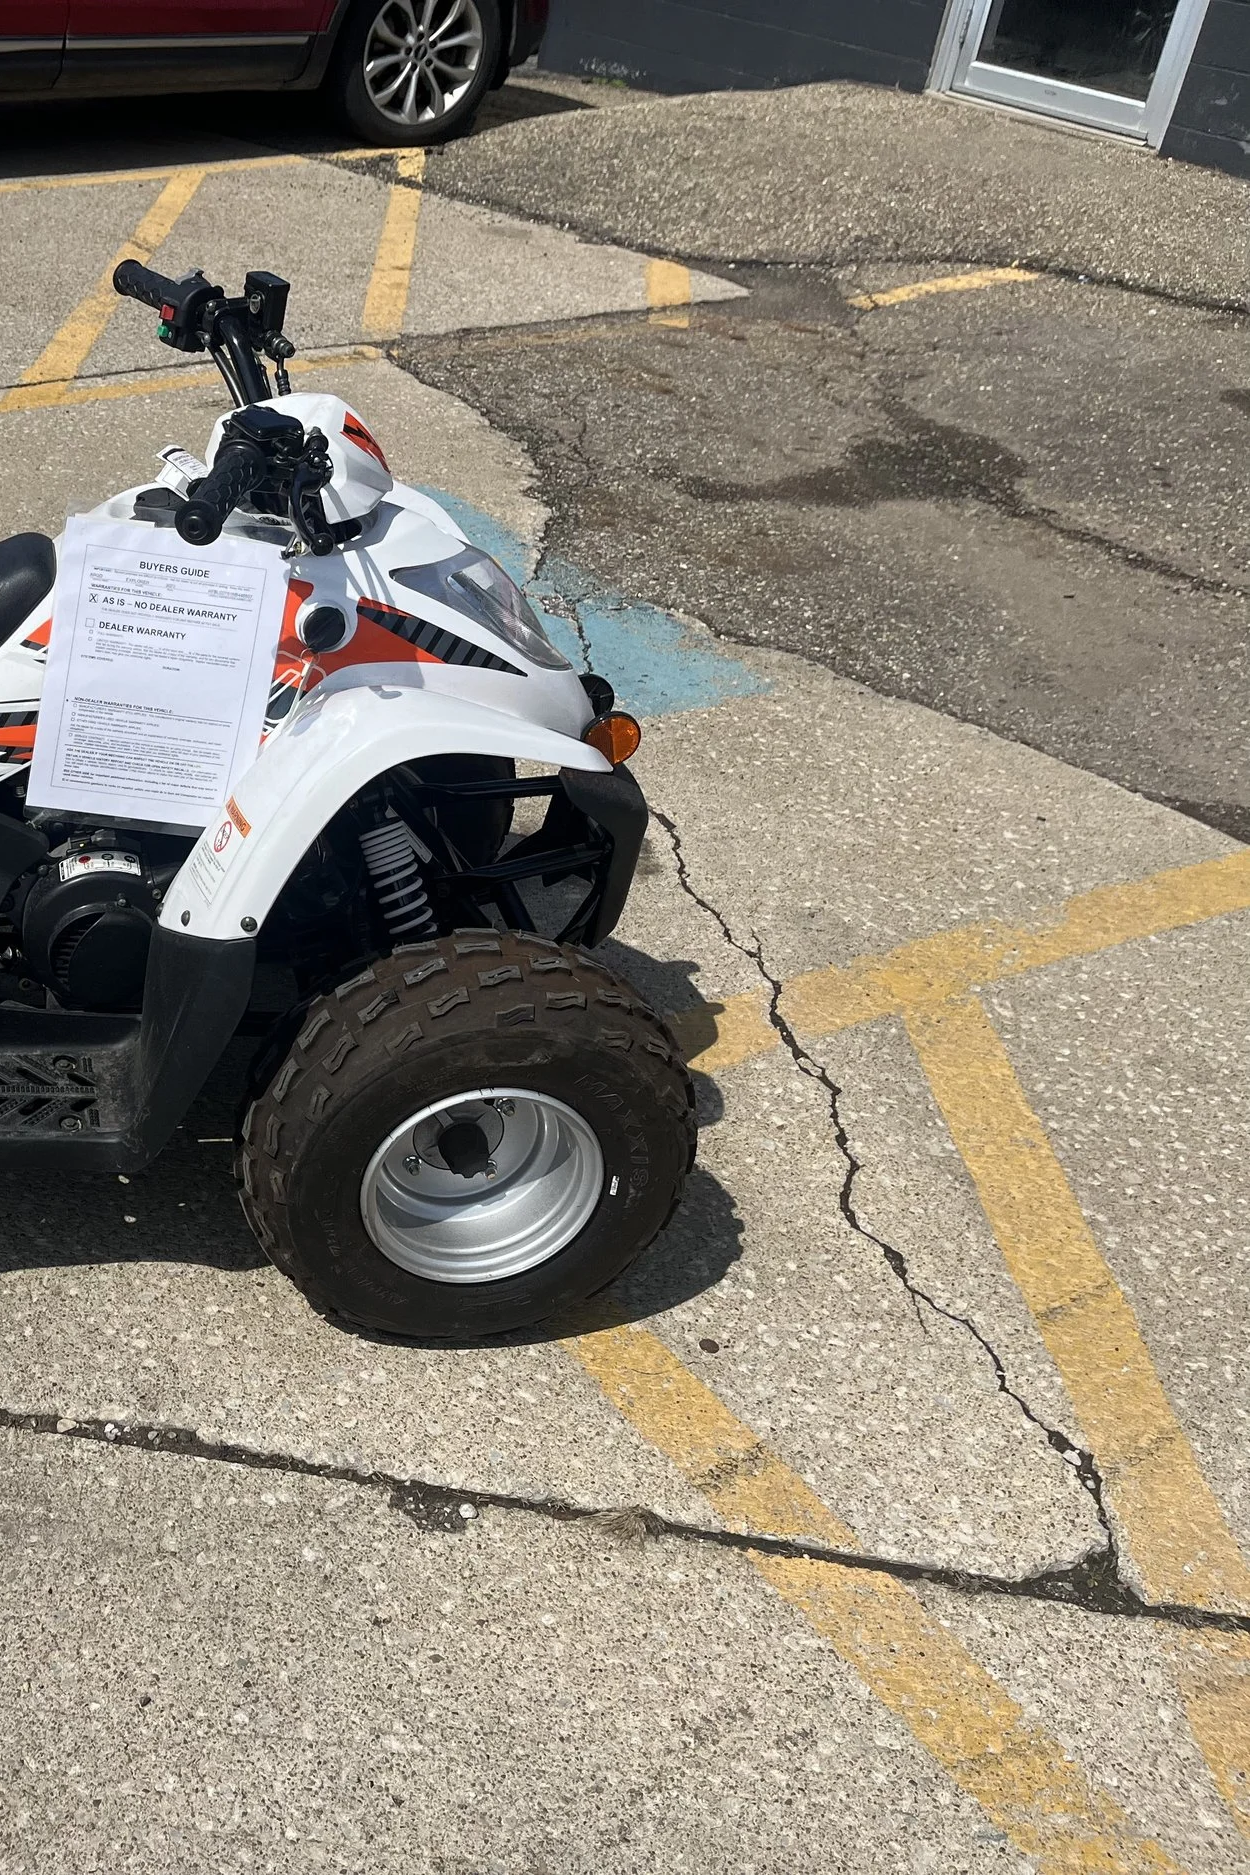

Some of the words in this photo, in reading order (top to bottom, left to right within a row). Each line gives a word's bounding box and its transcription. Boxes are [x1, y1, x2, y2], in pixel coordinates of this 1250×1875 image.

[139, 561, 179, 574] BUYERS
[180, 567, 211, 579] GUIDE
[102, 596, 115, 605] AS
[116, 598, 126, 607] IS
[134, 601, 148, 610] NO
[149, 603, 185, 615] DEALER
[186, 608, 237, 622] WARRANTY
[99, 621, 134, 633] DEALER
[136, 626, 186, 640] WARRANTY
